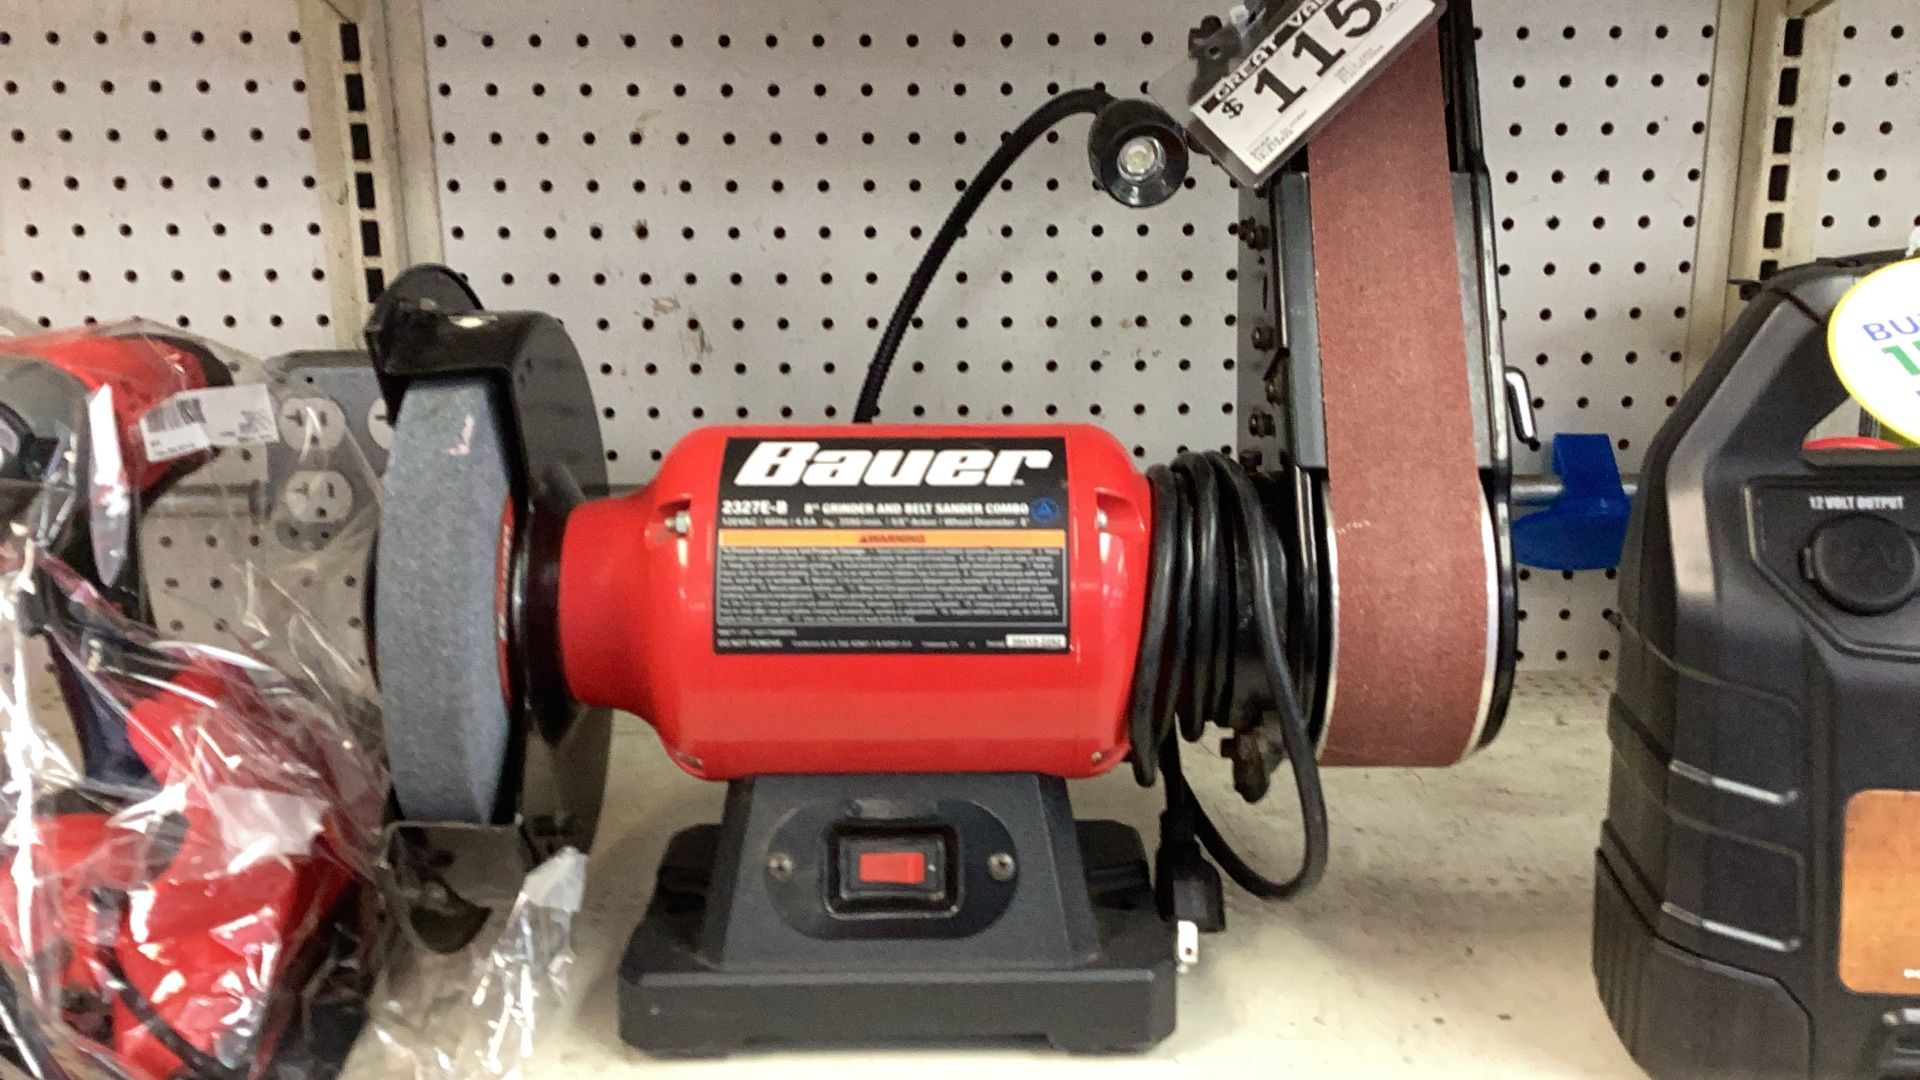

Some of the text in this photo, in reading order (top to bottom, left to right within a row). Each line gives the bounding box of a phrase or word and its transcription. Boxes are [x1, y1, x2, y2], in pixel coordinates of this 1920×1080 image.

[1215, 41, 1277, 101] GREAT
[1862, 314, 1920, 341] BU
[1881, 341, 1920, 375] 1
[734, 441, 1053, 486] Bauer
[822, 502, 875, 515] GRINDER
[877, 502, 903, 515] AND
[904, 502, 933, 515] BELT
[934, 502, 984, 515] SANDER
[985, 502, 1030, 515] COMBO
[1809, 495, 1904, 510] 12 VOLT OUTPUT
[867, 534, 926, 543] WARNING
